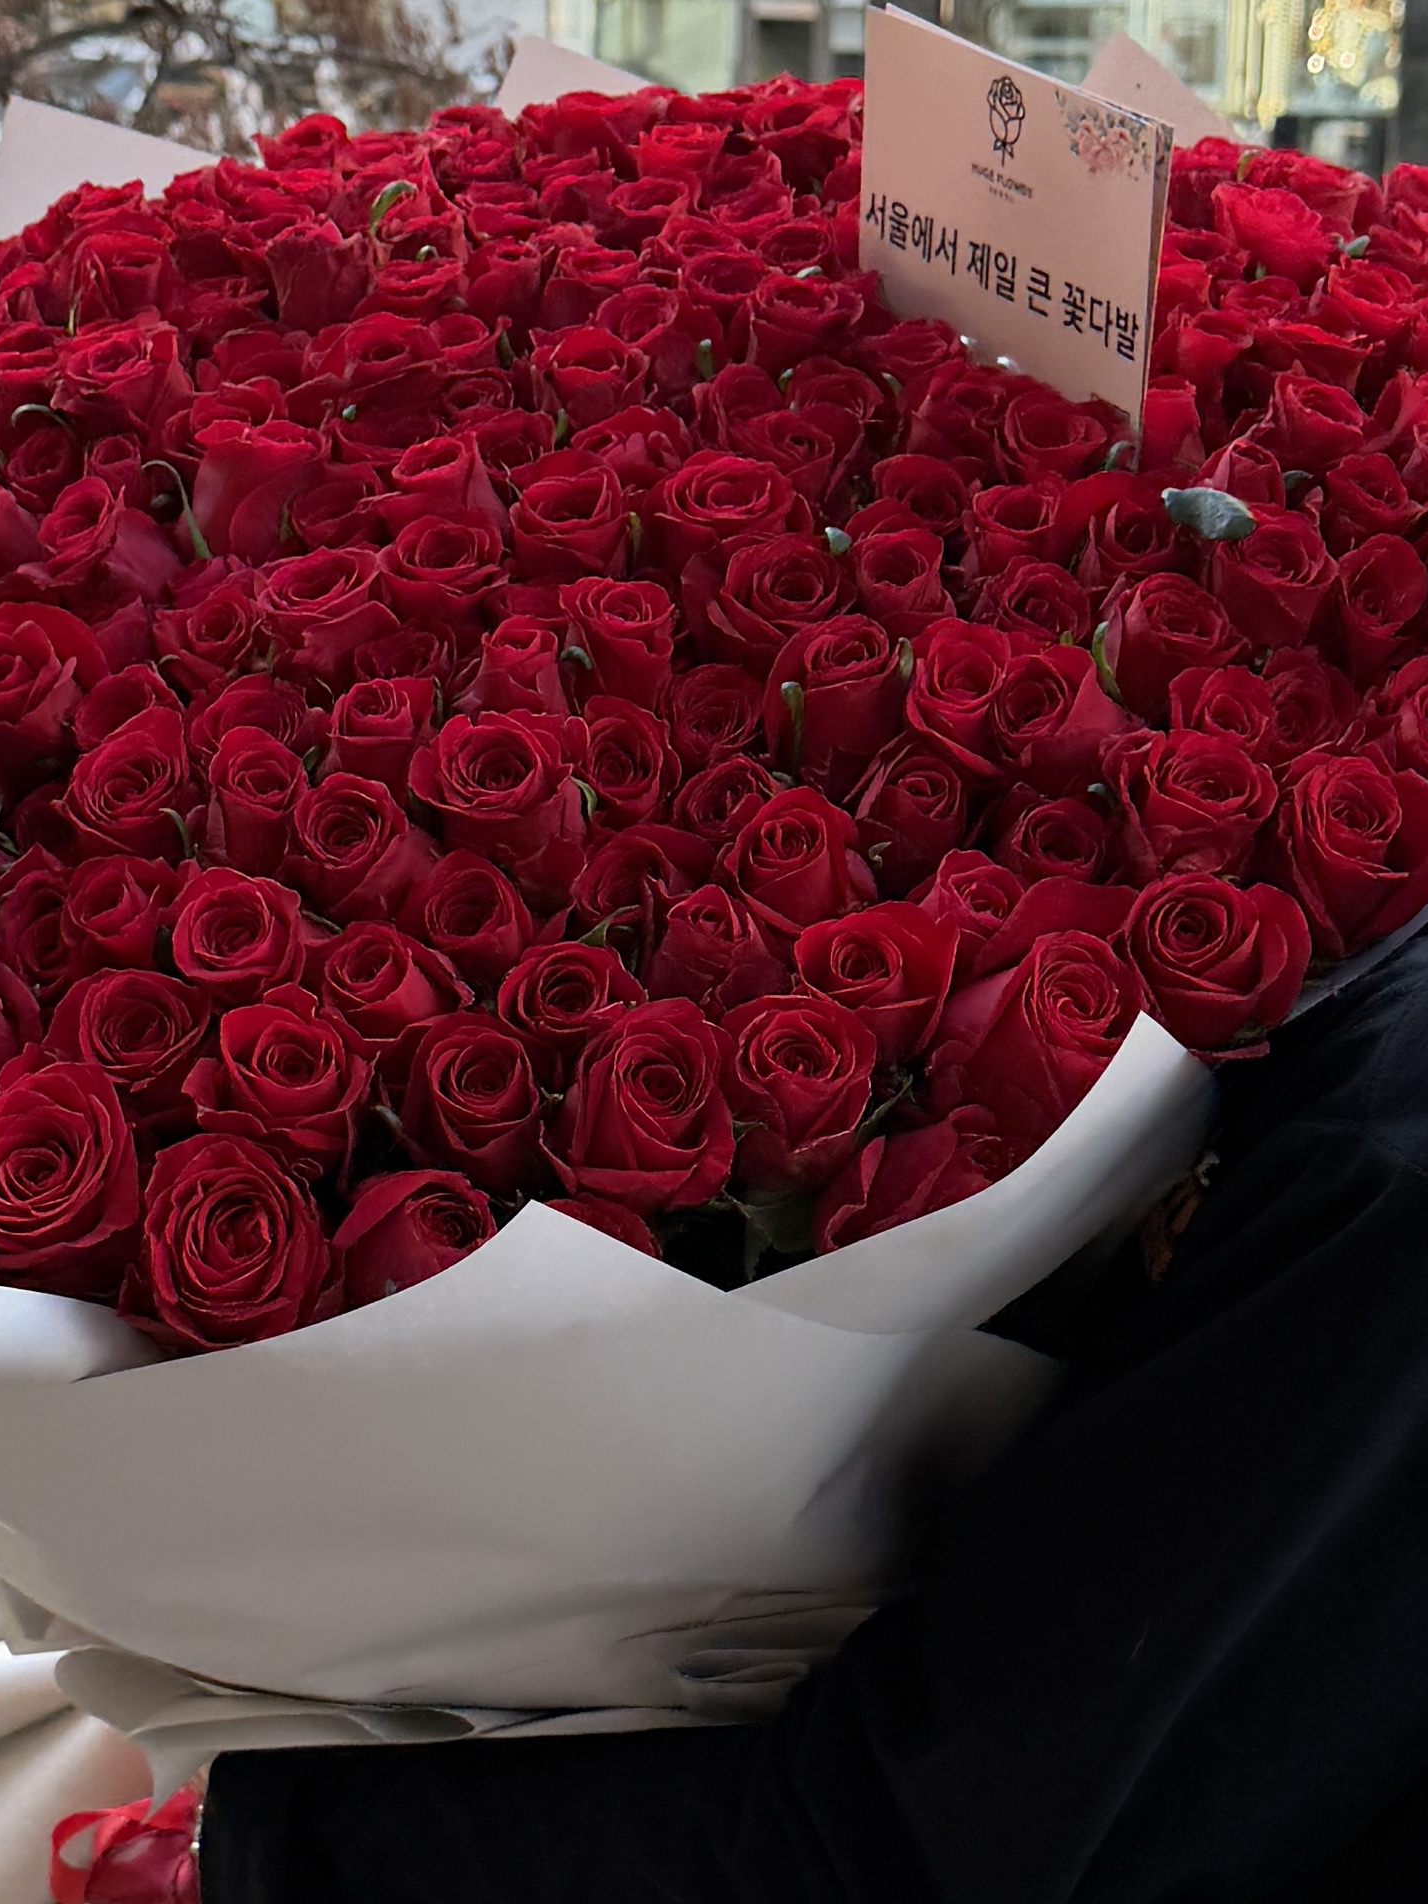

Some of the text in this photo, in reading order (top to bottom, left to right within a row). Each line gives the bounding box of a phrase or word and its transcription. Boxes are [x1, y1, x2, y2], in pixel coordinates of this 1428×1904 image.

[865, 192, 1140, 362] 서울에서 제일 큰 꽃다발
